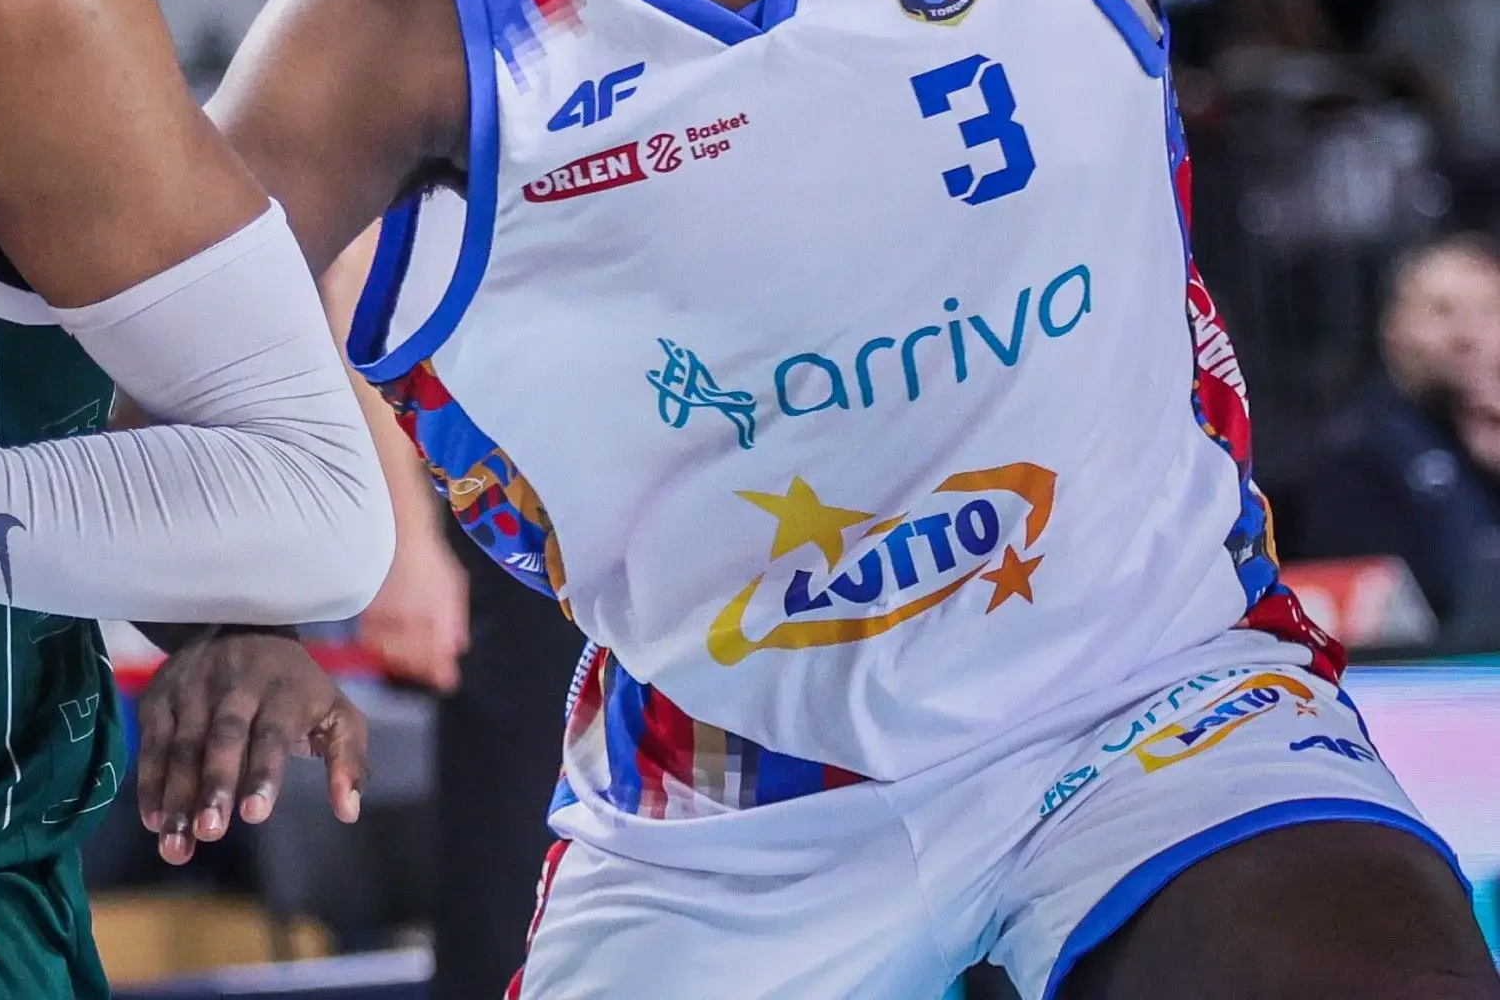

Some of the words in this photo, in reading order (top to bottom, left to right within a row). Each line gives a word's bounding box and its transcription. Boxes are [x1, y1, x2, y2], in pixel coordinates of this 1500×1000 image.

[685, 112, 749, 143] Basket
[690, 138, 731, 160] Liga
[910, 53, 1036, 205] 3
[530, 152, 633, 196] ORLEN
[774, 264, 1091, 416] arriva
[784, 499, 999, 617] LOTTO
